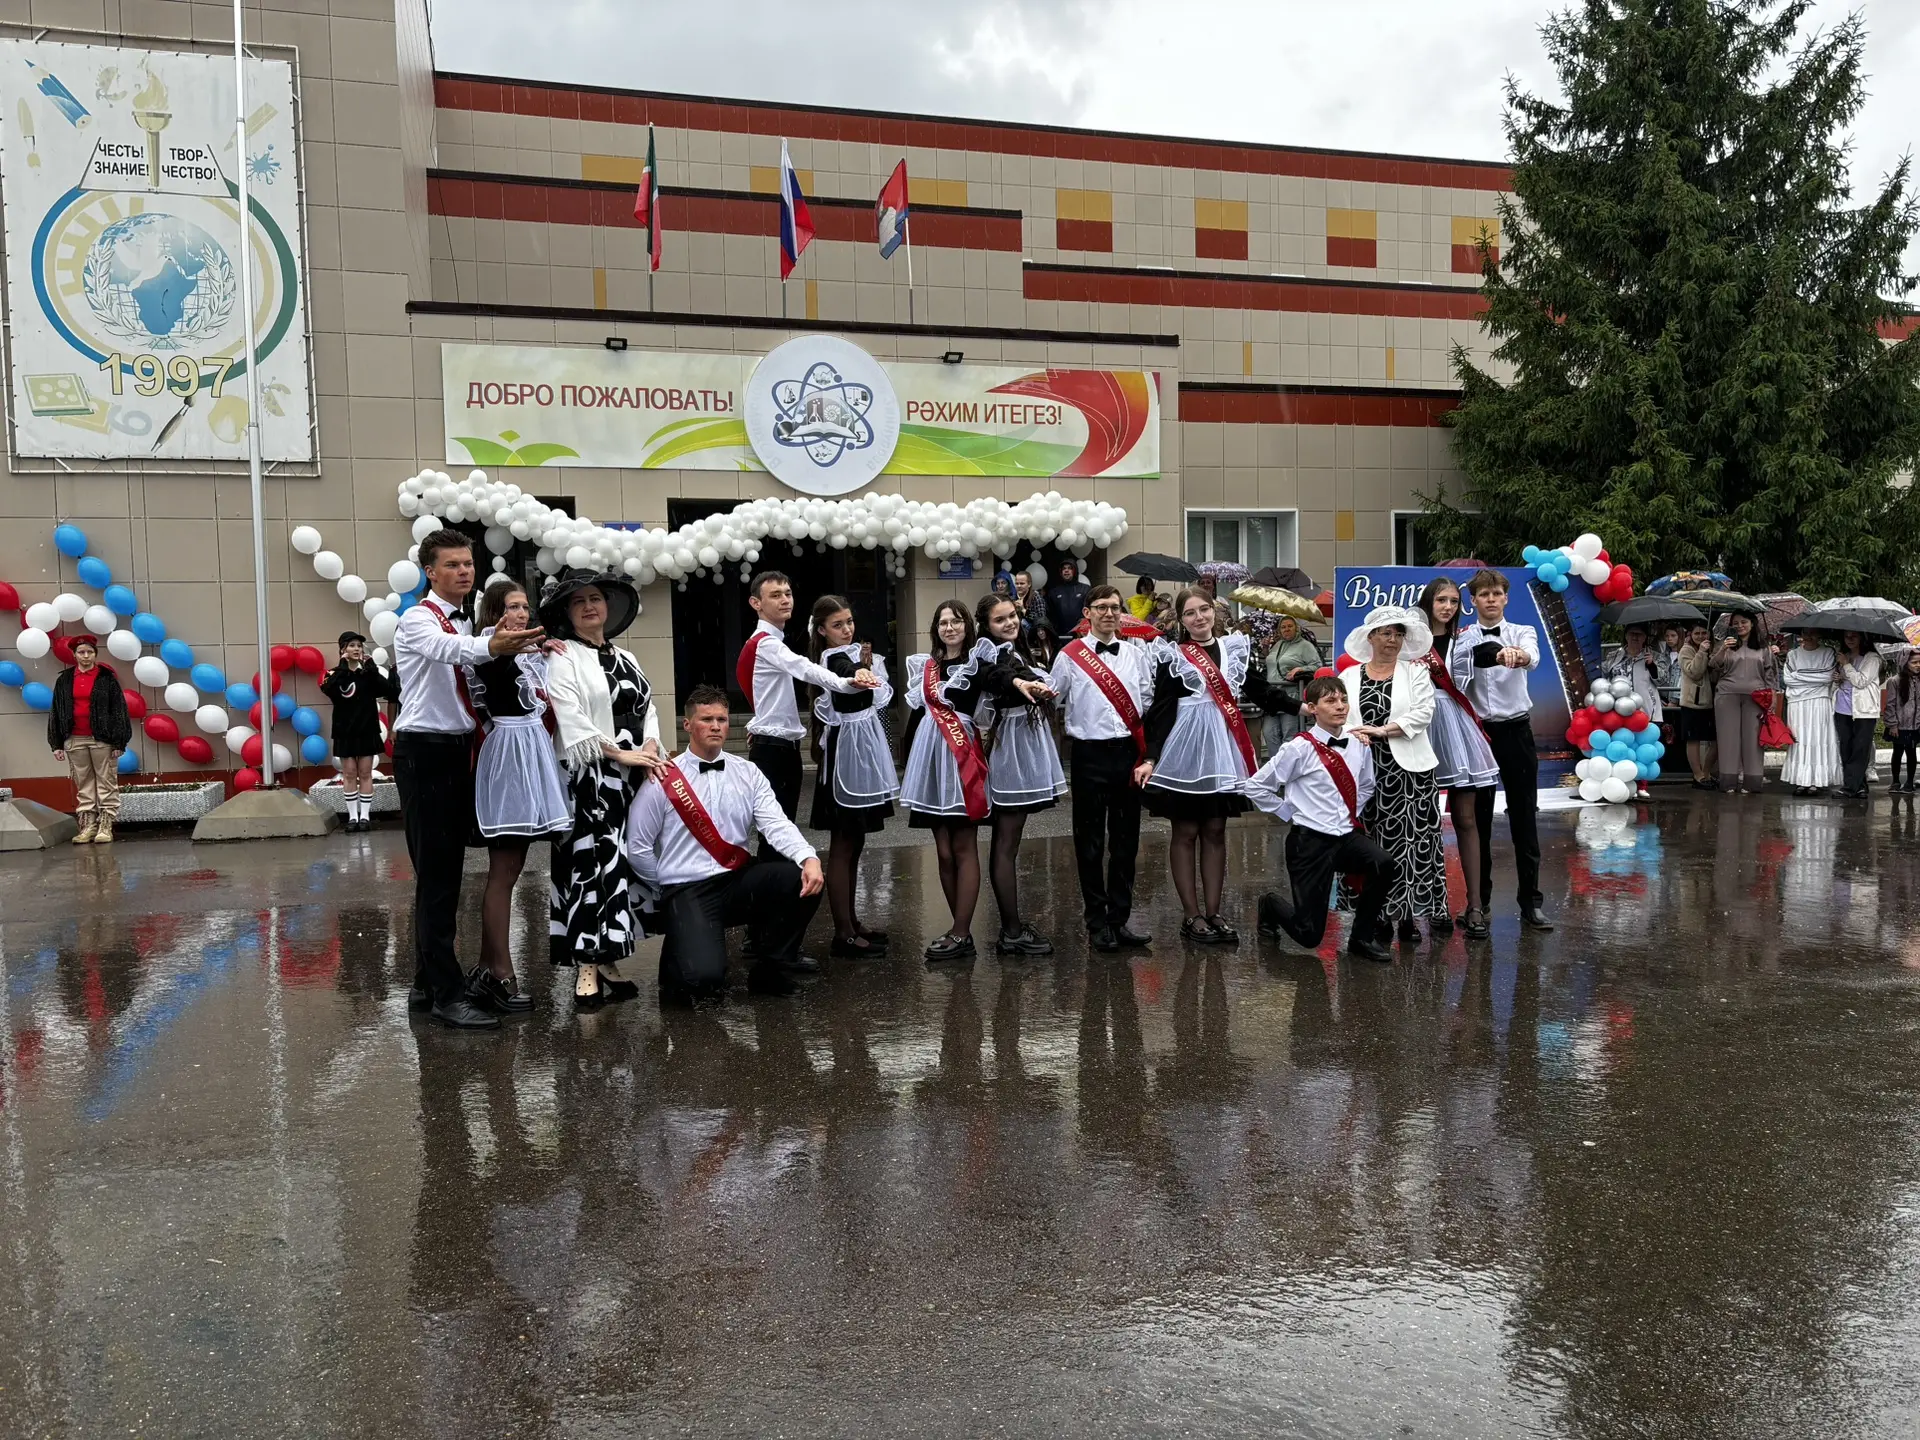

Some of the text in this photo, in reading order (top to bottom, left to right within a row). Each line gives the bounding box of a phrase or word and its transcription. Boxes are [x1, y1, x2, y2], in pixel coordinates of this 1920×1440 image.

[98, 144, 144, 158] ЧЕСТЬ!
[169, 147, 208, 162] ТВОР-
[94, 161, 150, 176] ЗНАНИЕ!
[161, 165, 217, 180] ЧЕСТВО!
[99, 352, 234, 399] 1997
[466, 382, 734, 412] ДОБРО ПОЖАЛОВАТЬ!
[906, 401, 1062, 425] РӘХИМ ИТЕГЕЗ!
[1078, 648, 1127, 706] ВЫПУСКНИК
[1223, 701, 1240, 727] 2026
[947, 721, 964, 747] 2026
